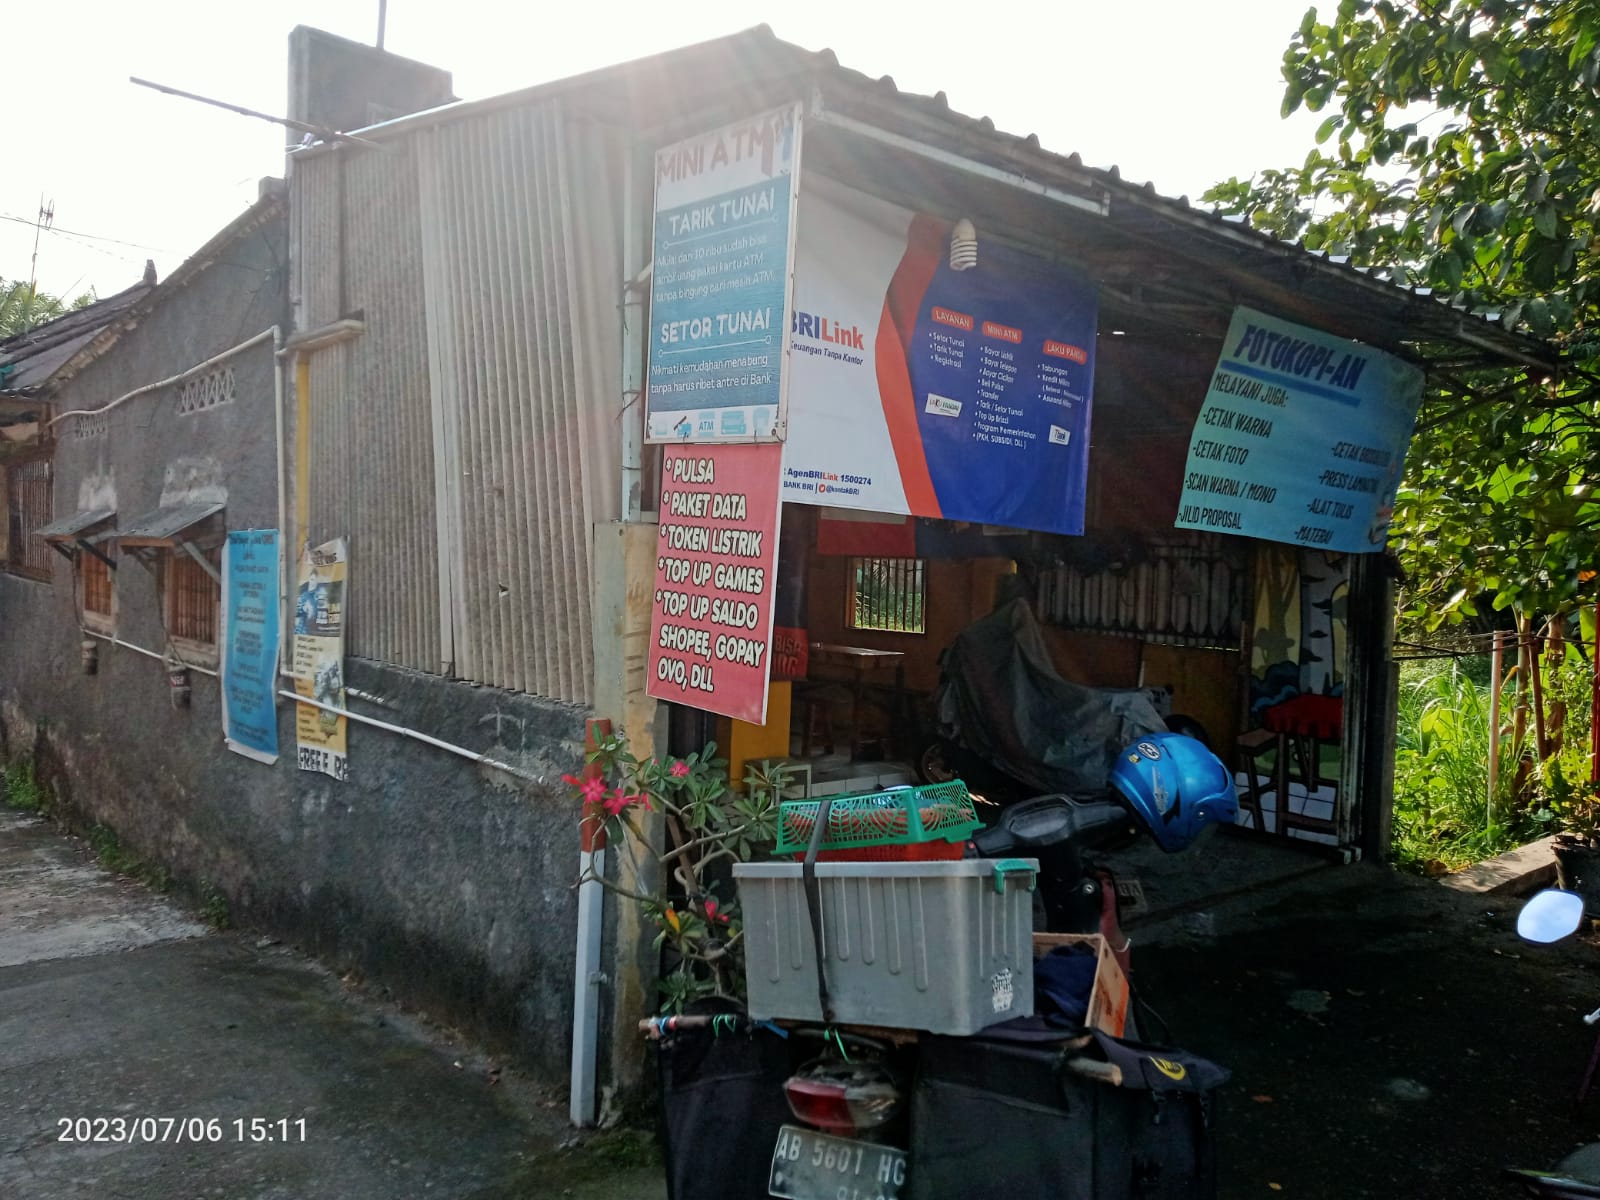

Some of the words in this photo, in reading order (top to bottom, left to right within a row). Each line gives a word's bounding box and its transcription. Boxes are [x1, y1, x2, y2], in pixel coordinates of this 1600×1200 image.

[668, 204, 715, 236] TARIK
[720, 187, 774, 223] TUNAI
[660, 316, 712, 344] SETOR
[716, 306, 771, 336] TUNAI
[935, 309, 970, 327] LAYANAN
[948, 336, 965, 348] Tunai
[1003, 329, 1018, 340] ATM
[823, 347, 842, 361] Tanpa
[842, 352, 864, 366] Kantor
[948, 347, 964, 358] Tunai
[1047, 343, 1065, 356] LAKU
[1232, 324, 1367, 391] FOTOKOPI-AN
[679, 359, 724, 374] kemudahan
[651, 384, 673, 396] tanpa
[673, 381, 695, 391] harus
[695, 378, 715, 390] ribet
[716, 377, 739, 388] antre
[740, 374, 749, 386] di
[750, 371, 771, 385] Bank
[1213, 371, 1261, 398] MELAYANI
[698, 420, 714, 432] ATM
[1235, 413, 1274, 439] WARNA
[1225, 446, 1249, 466] FOTO
[672, 457, 715, 484] PULSA
[788, 467, 839, 482] AgenBRILink
[840, 474, 872, 486] 1500274
[783, 480, 801, 489] BANK
[801, 483, 814, 491] BRI
[1208, 477, 1239, 497] WARNA
[1247, 482, 1278, 504] MONO
[670, 491, 711, 518] PAKET
[711, 494, 747, 521] DATA
[1201, 507, 1243, 530] PROPOSAL
[667, 524, 710, 552] TOKEN
[711, 527, 763, 558] LISTRIK
[665, 557, 691, 584] TOP
[692, 560, 712, 587] UP
[714, 564, 764, 595] GAMES
[662, 590, 688, 617] TOP
[690, 594, 710, 621] UP
[710, 597, 759, 630] SALDO
[659, 623, 712, 662] SHOPEE,
[715, 635, 765, 668] GOPAY
[657, 656, 688, 692] OVO,
[690, 664, 715, 693] DLL
[776, 1132, 803, 1162] AB
[811, 1139, 864, 1175] 5601
